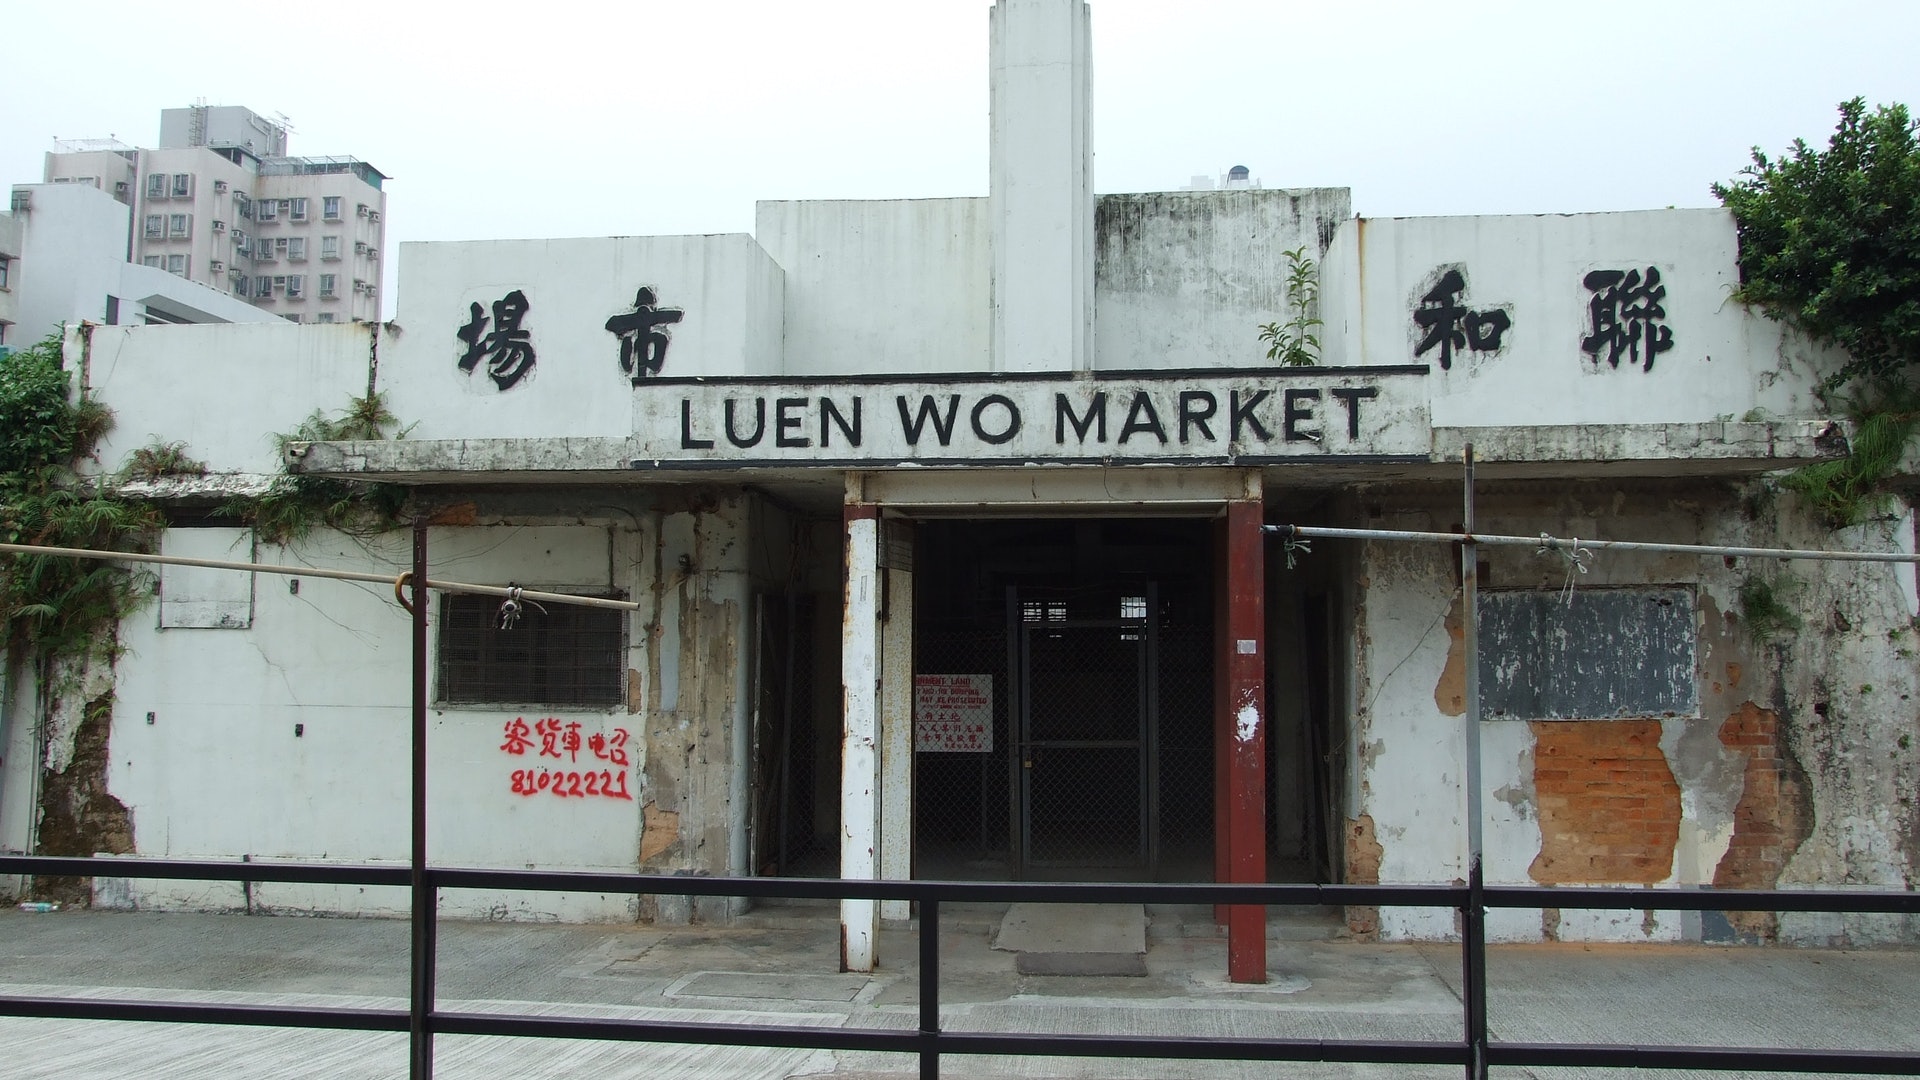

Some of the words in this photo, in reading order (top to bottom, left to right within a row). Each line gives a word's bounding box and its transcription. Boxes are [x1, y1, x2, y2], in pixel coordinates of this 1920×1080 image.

[681, 396, 862, 450] LUEN
[896, 393, 1022, 446] WO
[1055, 387, 1377, 445] MARKET
[510, 769, 633, 800] 81022221
